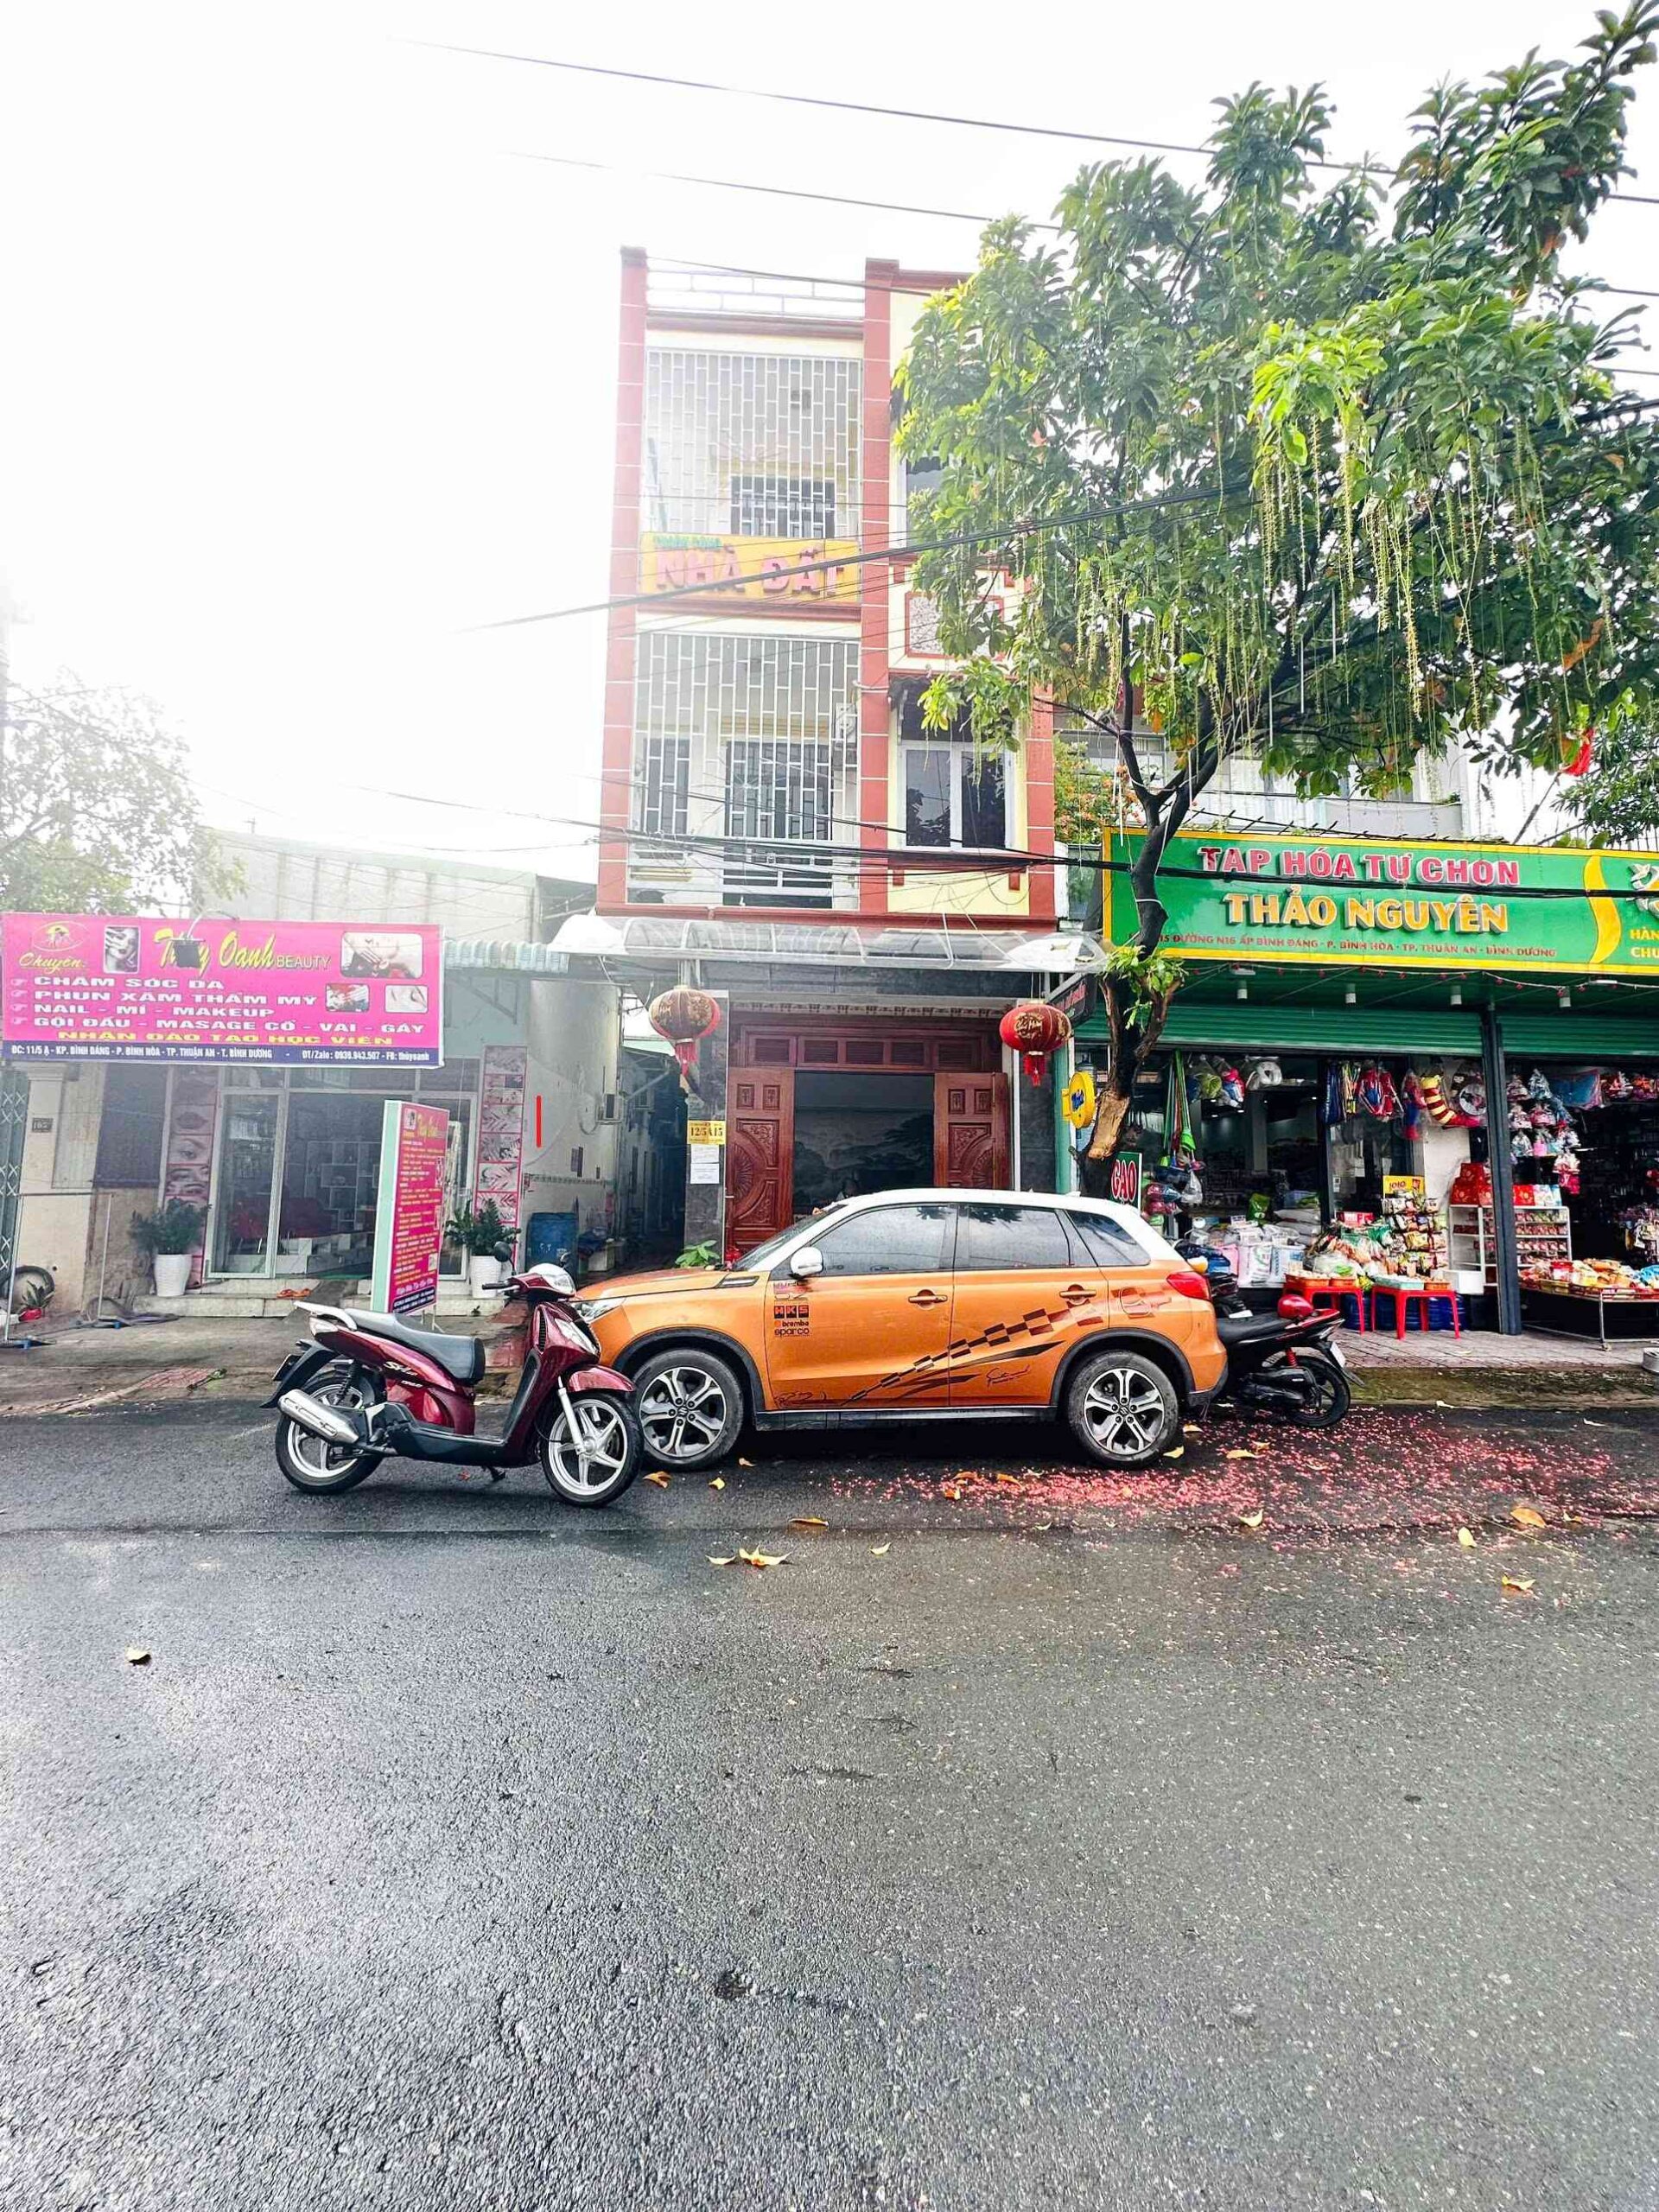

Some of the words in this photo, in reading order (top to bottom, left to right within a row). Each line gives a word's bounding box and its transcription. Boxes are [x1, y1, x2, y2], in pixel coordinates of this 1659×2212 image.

[656, 544, 747, 593] NHÀ
[760, 545, 844, 596] ĐẤT
[1279, 847, 1357, 879] HÓA
[1222, 884, 1338, 927] THẢO
[1344, 893, 1509, 933] NGUYÊN
[219, 930, 276, 970] Oanh
[276, 955, 331, 969] BEAUTY
[1173, 932, 1214, 944] ĐƯỜNG
[1256, 934, 1285, 947] BÌNH
[1340, 939, 1368, 950] BÌNH
[1463, 945, 1478, 954] AN
[1486, 944, 1513, 956] BÌNH
[188, 979, 225, 989] DA
[35, 989, 111, 1001] PHUN
[34, 1003, 90, 1014] NAIL
[173, 1006, 275, 1018] MAKEUP
[156, 1019, 256, 1030] MASAGE
[319, 1022, 357, 1033] VAI
[268, 1035, 321, 1046] HỌC
[26, 1046, 42, 1055] 11/5
[56, 1046, 69, 1055] KP.
[167, 1047, 179, 1057] TP.
[774, 1305, 809, 1319] HKS
